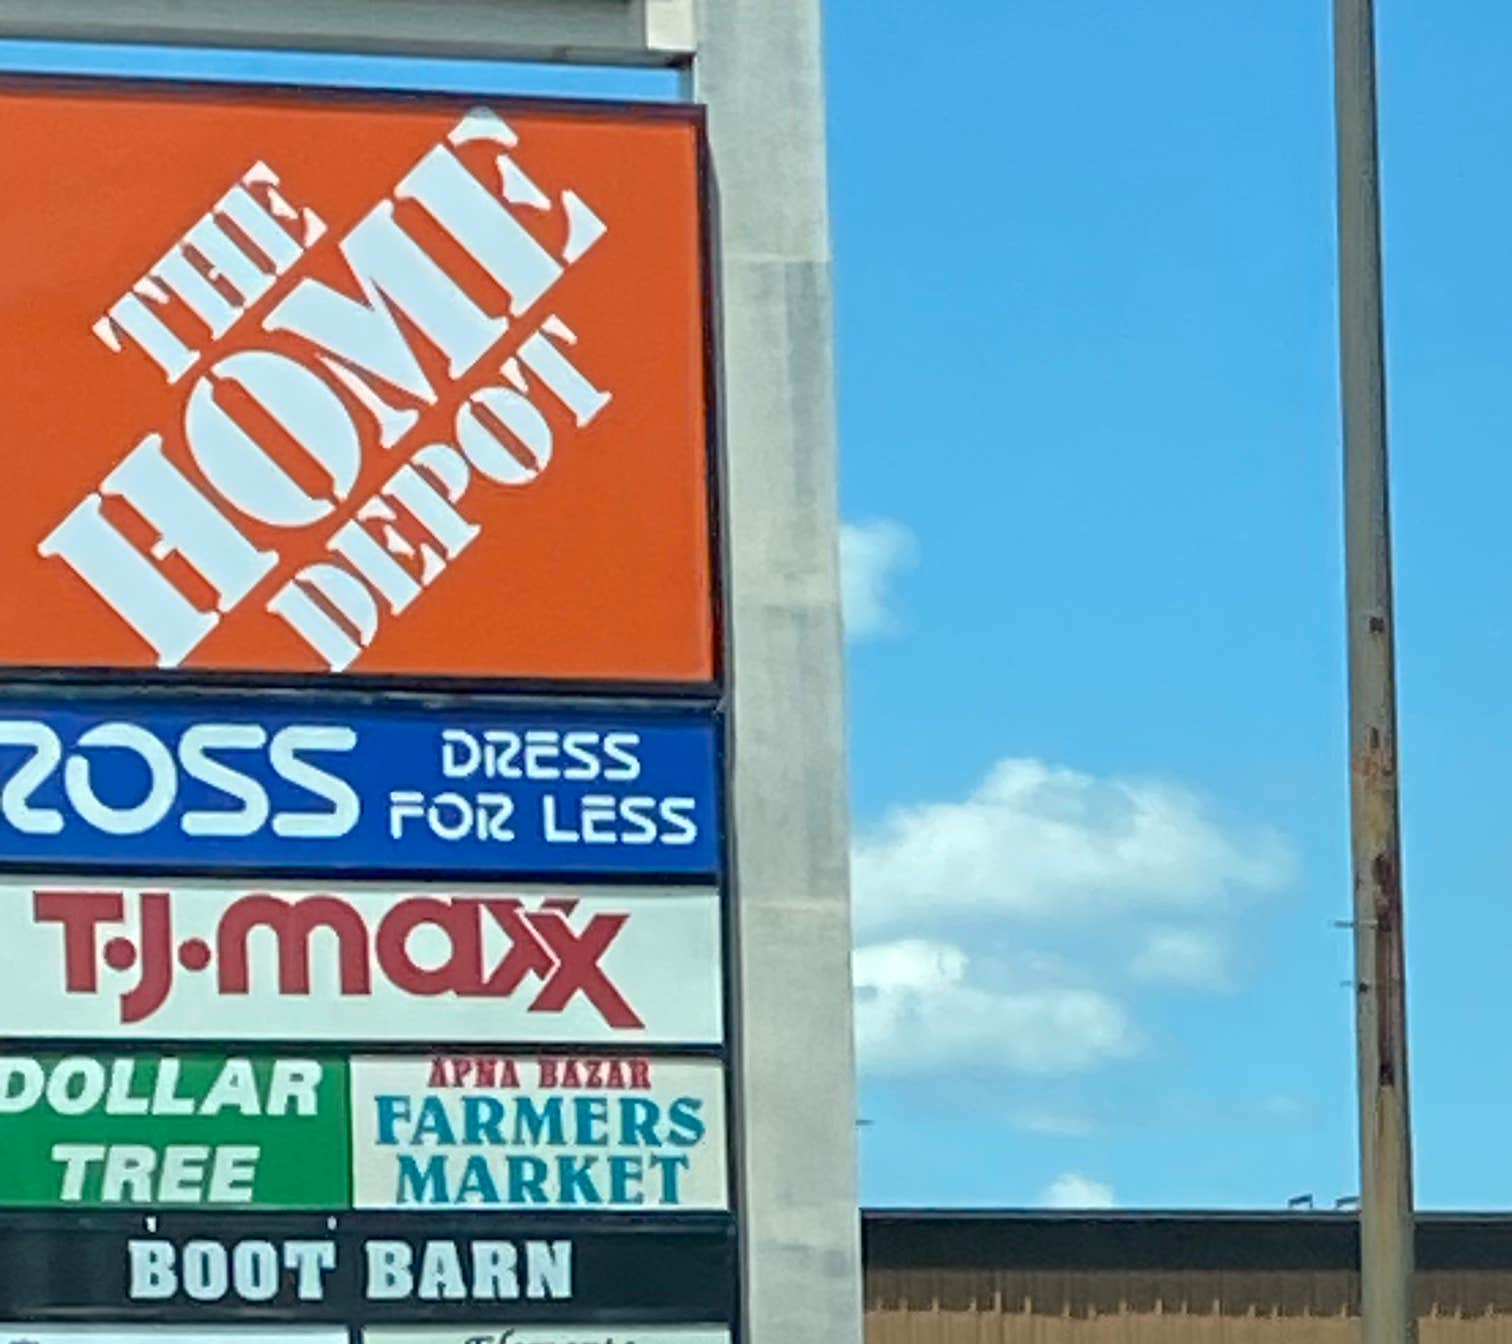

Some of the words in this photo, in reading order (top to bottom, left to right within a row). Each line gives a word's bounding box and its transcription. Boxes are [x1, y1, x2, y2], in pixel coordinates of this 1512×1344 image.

[92, 160, 328, 385] THE
[37, 106, 608, 670] HOME
[265, 314, 612, 673] DEPOT
[441, 729, 641, 781] DRESS
[389, 790, 515, 842] FOR
[543, 794, 698, 845] LESS
[0, 1056, 322, 1116] DOLLAR
[427, 1057, 521, 1088] APNA
[538, 1057, 653, 1089] BAZAR
[374, 1094, 706, 1147] FARMERS
[52, 1144, 261, 1203] TREE
[395, 1153, 689, 1205] MARKET
[128, 1239, 337, 1301] BOOT
[365, 1240, 574, 1300] BARN
